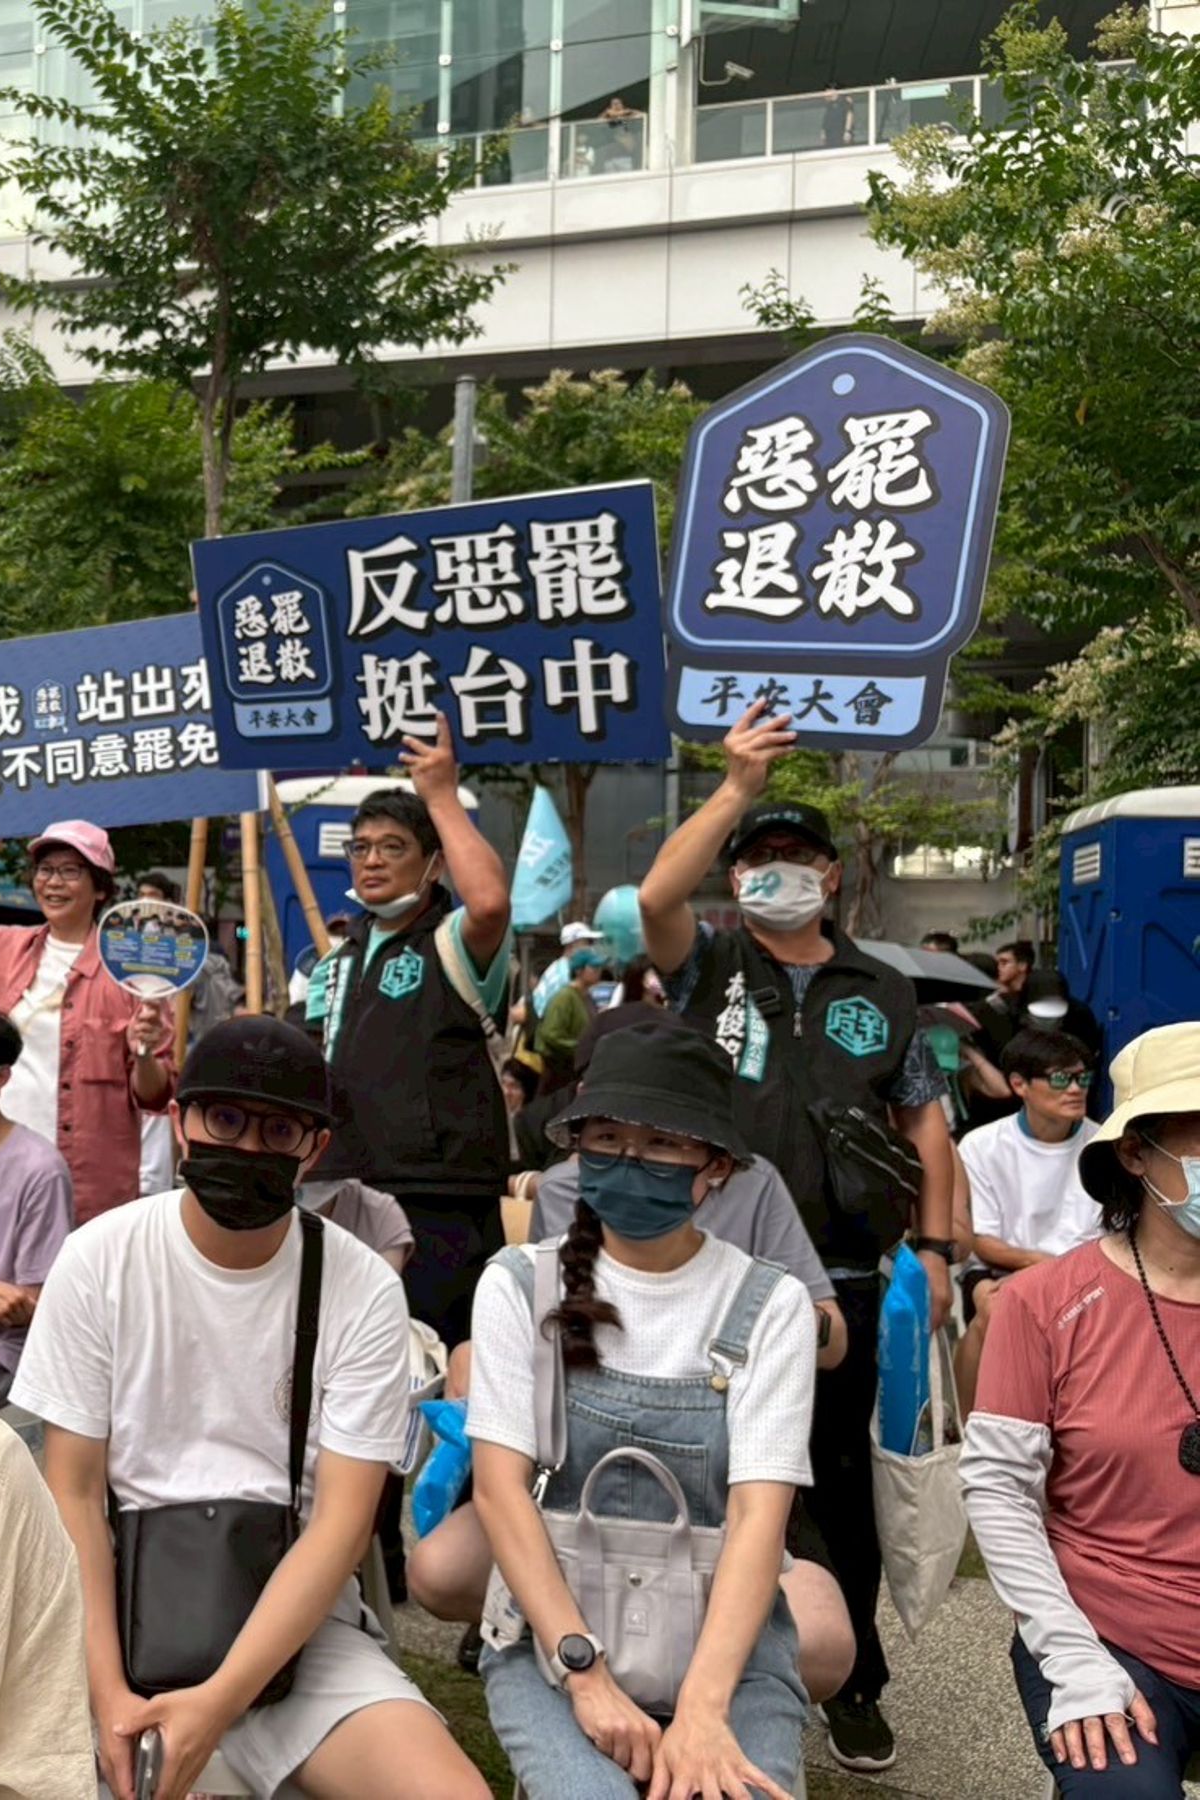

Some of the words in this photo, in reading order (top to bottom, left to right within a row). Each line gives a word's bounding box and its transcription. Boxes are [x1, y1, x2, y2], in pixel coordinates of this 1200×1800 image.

[722, 407, 933, 514] 惡罷
[347, 511, 629, 637] 反惡罷
[704, 517, 917, 619] 退散
[233, 588, 313, 640] 惡罷
[237, 636, 318, 685] 退散
[355, 637, 631, 742] 挺台中
[247, 706, 319, 730] 平安大會
[700, 675, 895, 729] 平安大會
